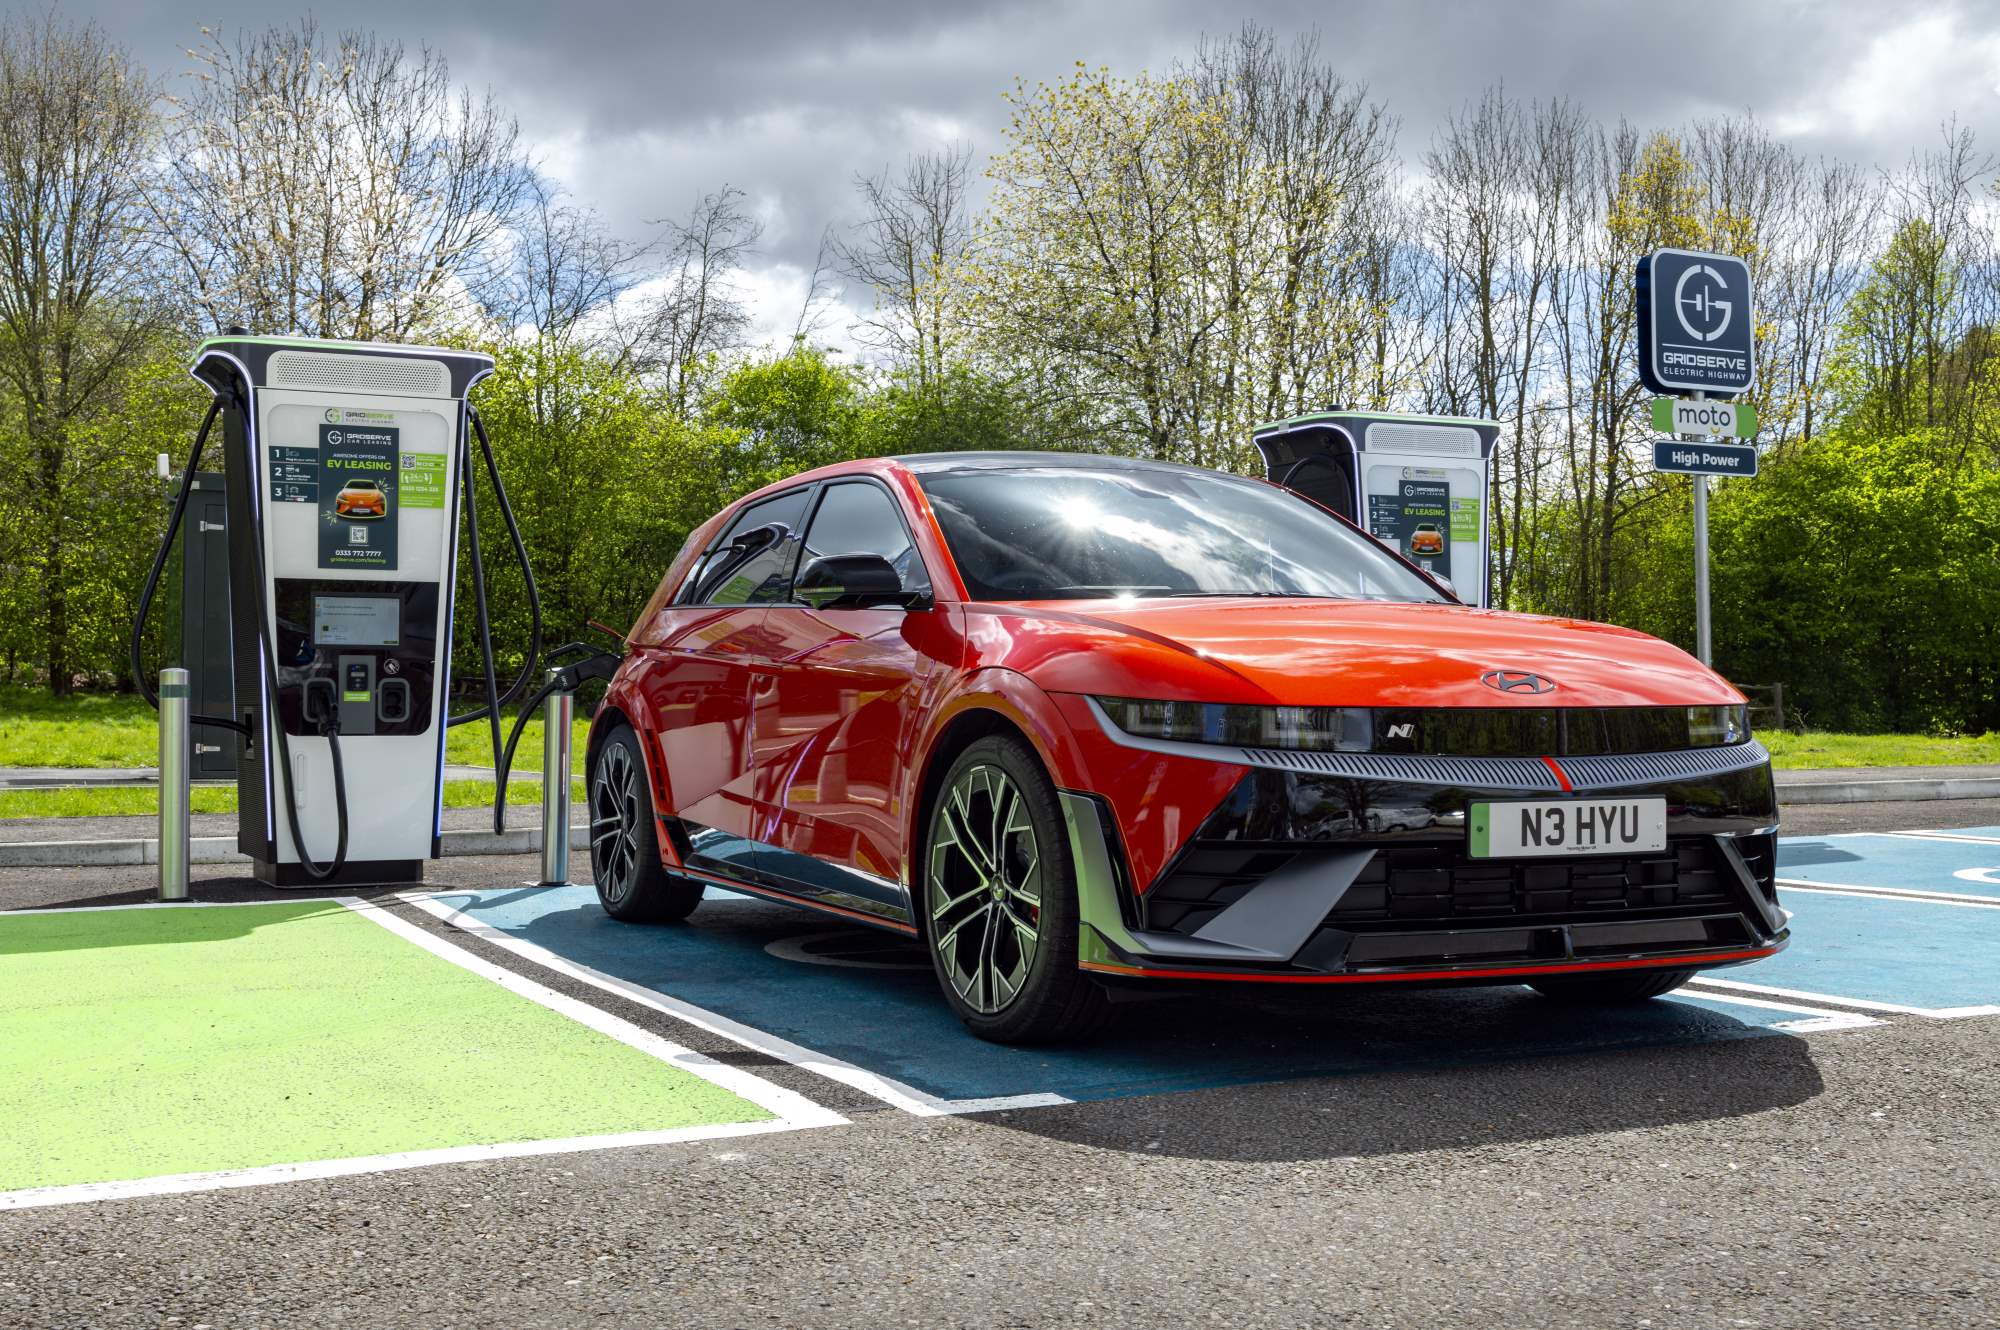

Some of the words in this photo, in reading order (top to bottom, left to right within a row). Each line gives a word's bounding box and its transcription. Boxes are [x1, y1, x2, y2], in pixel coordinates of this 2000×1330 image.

[1663, 352, 1746, 370] GRIDSERVE
[1663, 366, 1704, 377] ELECTRIC
[1708, 371, 1746, 381] HIGHWAY
[1678, 406, 1731, 427] moto
[346, 433, 392, 441] GRIDSERVE
[274, 449, 280, 458] 1
[1672, 451, 1699, 467] High
[1702, 453, 1739, 467] Power
[327, 459, 342, 469] EV
[344, 460, 392, 471] LEASING
[274, 467, 282, 477] 2
[274, 487, 282, 497] 3
[1371, 496, 1376, 505] 1
[1371, 511, 1378, 519] 2
[1404, 507, 1415, 516] EV
[1415, 508, 1446, 517] LEASING
[1372, 527, 1378, 535] 3
[352, 549, 365, 557] 772
[1521, 807, 1565, 847] N3
[1576, 805, 1639, 845] HYU
